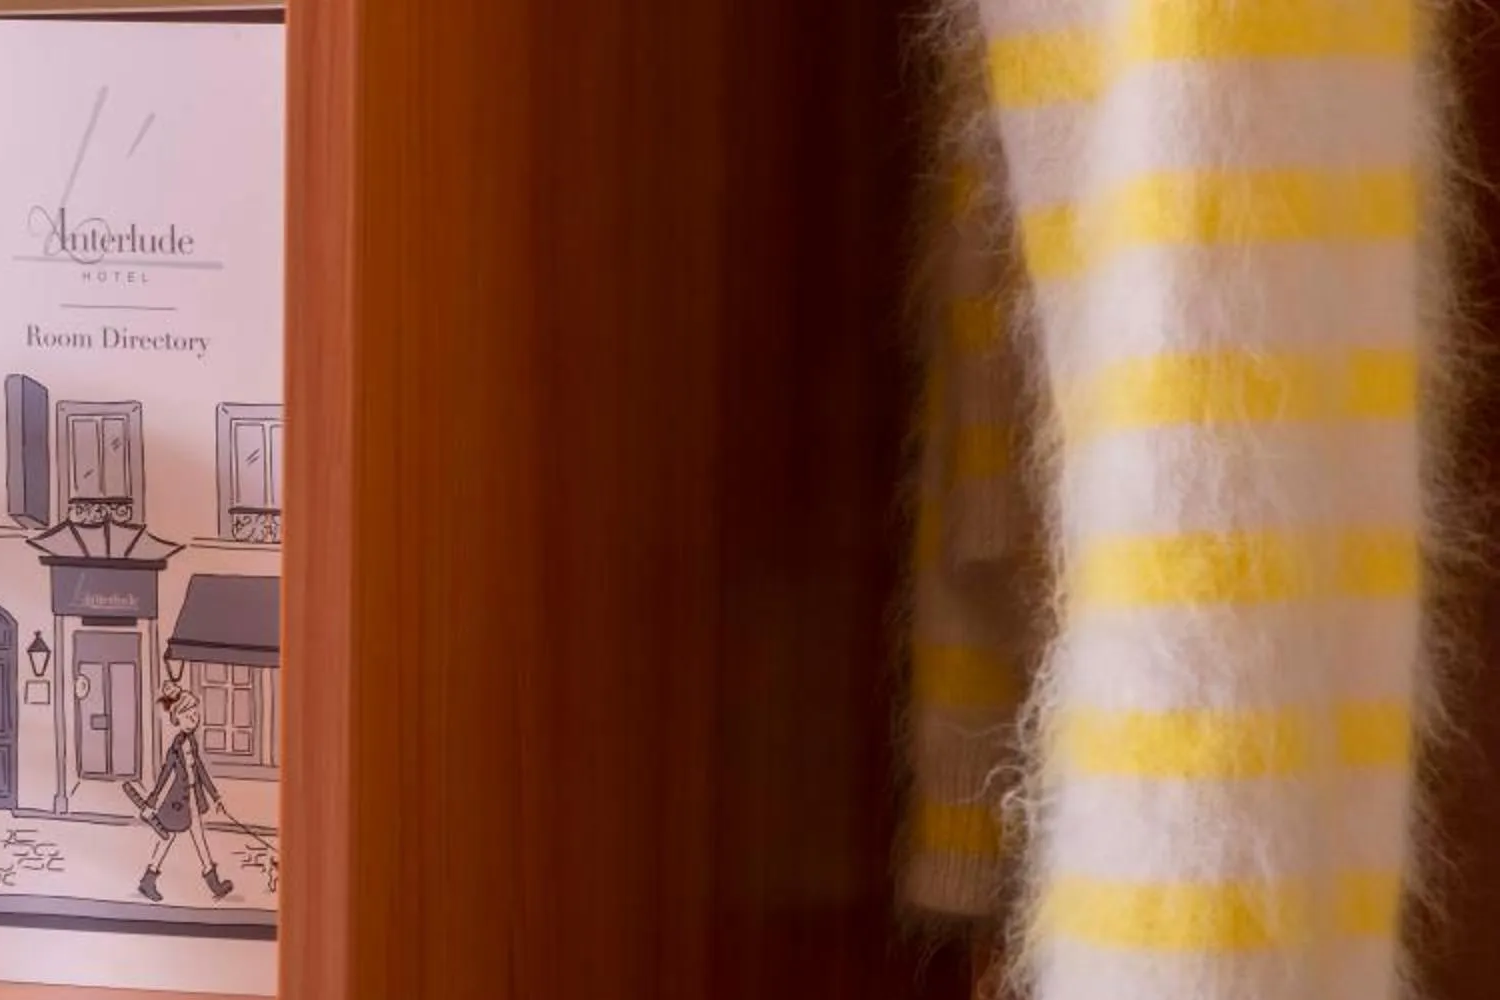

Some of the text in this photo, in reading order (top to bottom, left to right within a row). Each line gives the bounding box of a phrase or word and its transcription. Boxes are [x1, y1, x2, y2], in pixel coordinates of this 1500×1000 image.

[82, 271, 150, 284] HOTEL
[26, 324, 211, 360] Room Directory
